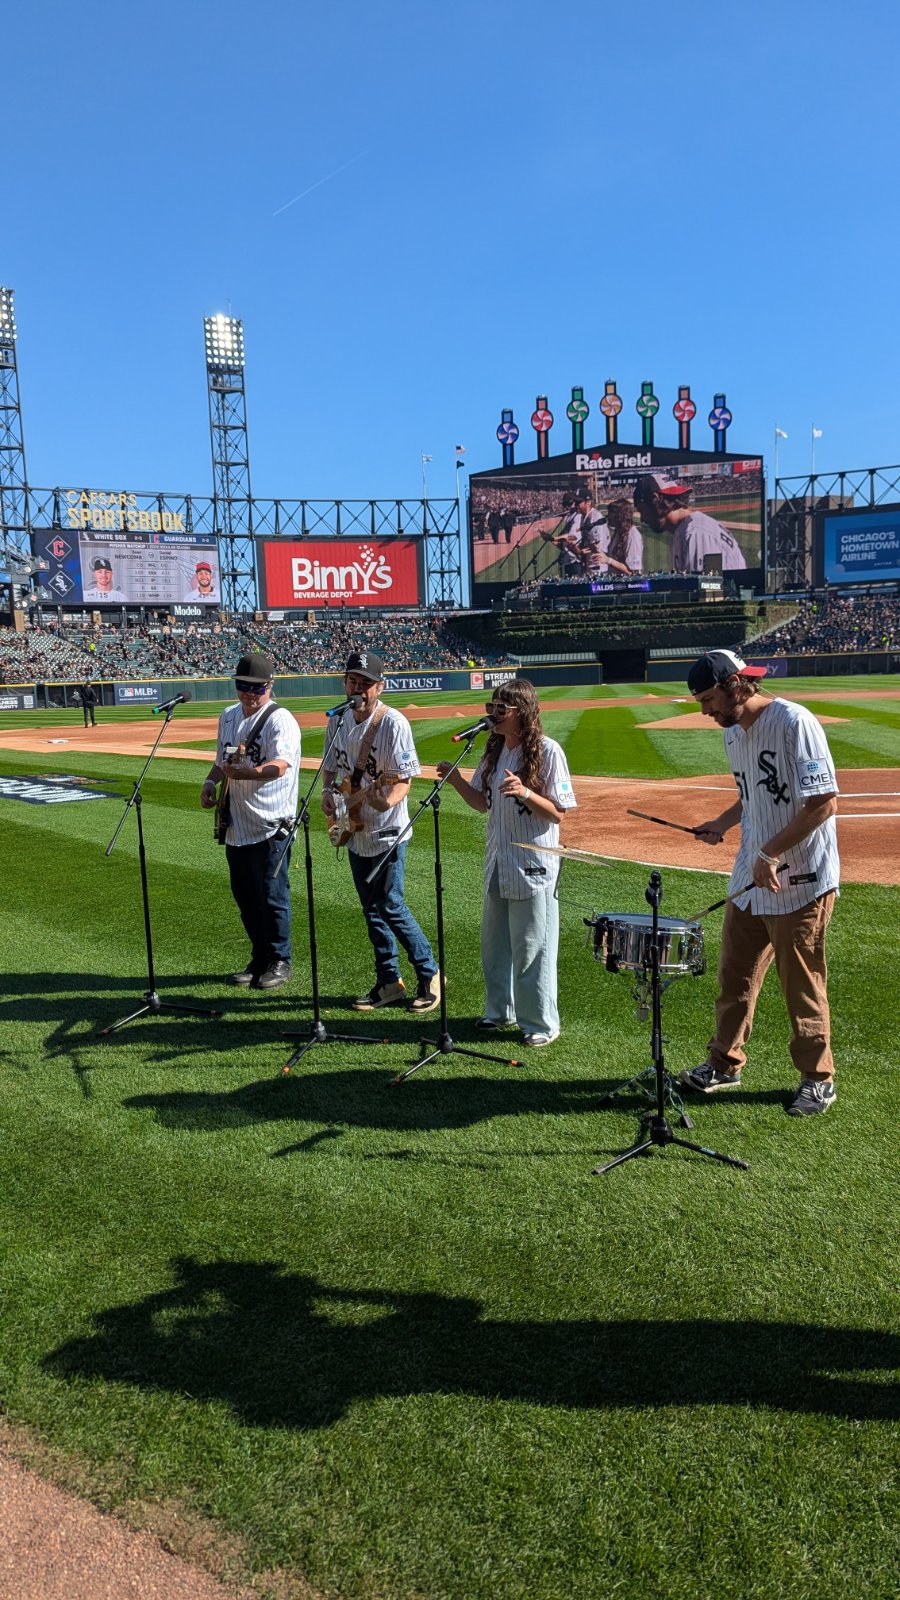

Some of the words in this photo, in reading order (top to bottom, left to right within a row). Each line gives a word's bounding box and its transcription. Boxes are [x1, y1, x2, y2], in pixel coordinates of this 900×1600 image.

[575, 453, 612, 470] Rate
[614, 453, 651, 468] Field
[66, 490, 137, 507] CAESARS
[67, 507, 186, 534] SPORTSBOOK
[841, 531, 896, 543] CHICAGO'S
[841, 541, 900, 553] HOMETOWN
[841, 551, 877, 562] AIRLINE
[174, 605, 202, 616] Modelo
[484, 672, 517, 680] STREAM
[383, 677, 443, 690] INTRUST
[134, 687, 158, 696] MLB+
[399, 759, 418, 771] CME
[801, 772, 830, 787] CME
